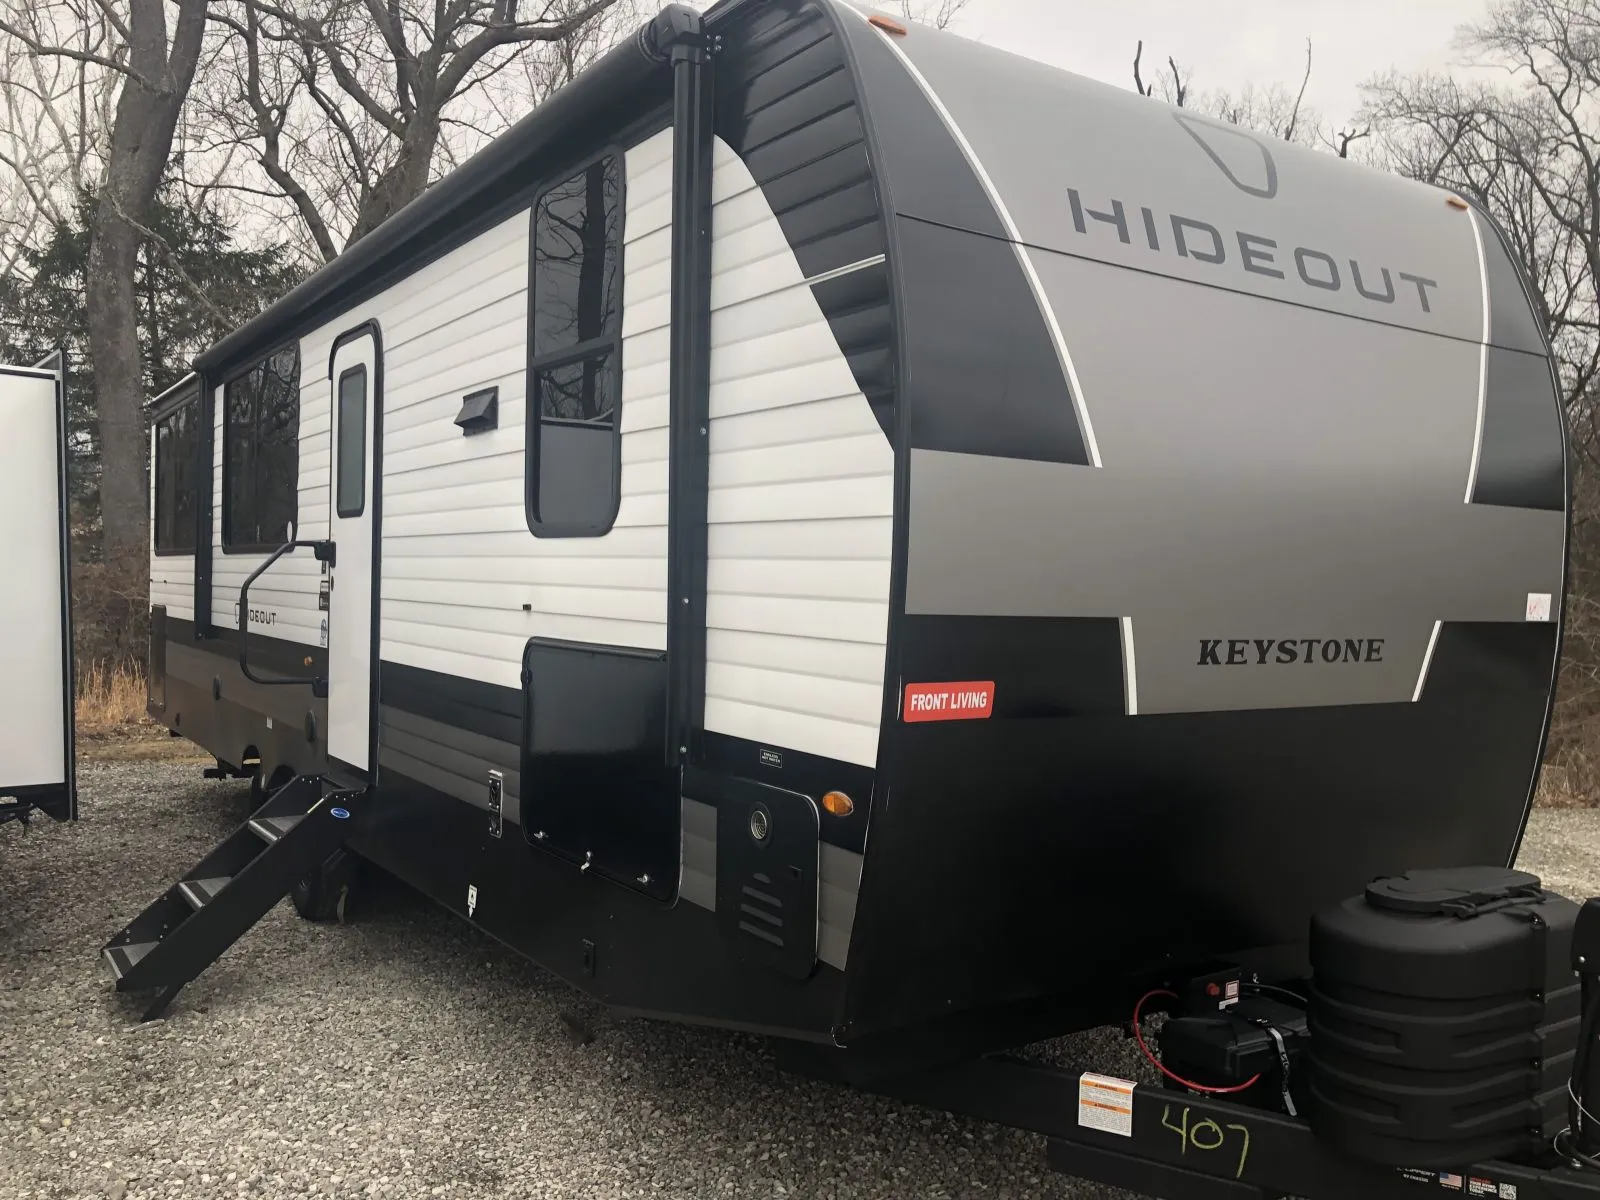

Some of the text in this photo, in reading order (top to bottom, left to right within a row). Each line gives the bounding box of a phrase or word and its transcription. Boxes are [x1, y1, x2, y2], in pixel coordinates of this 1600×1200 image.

[1066, 188, 1437, 313] HIDEOUT
[1197, 638, 1385, 666] KEYSTONE
[911, 691, 987, 711] FRONT LIVING
[1161, 1104, 1250, 1179] 407
